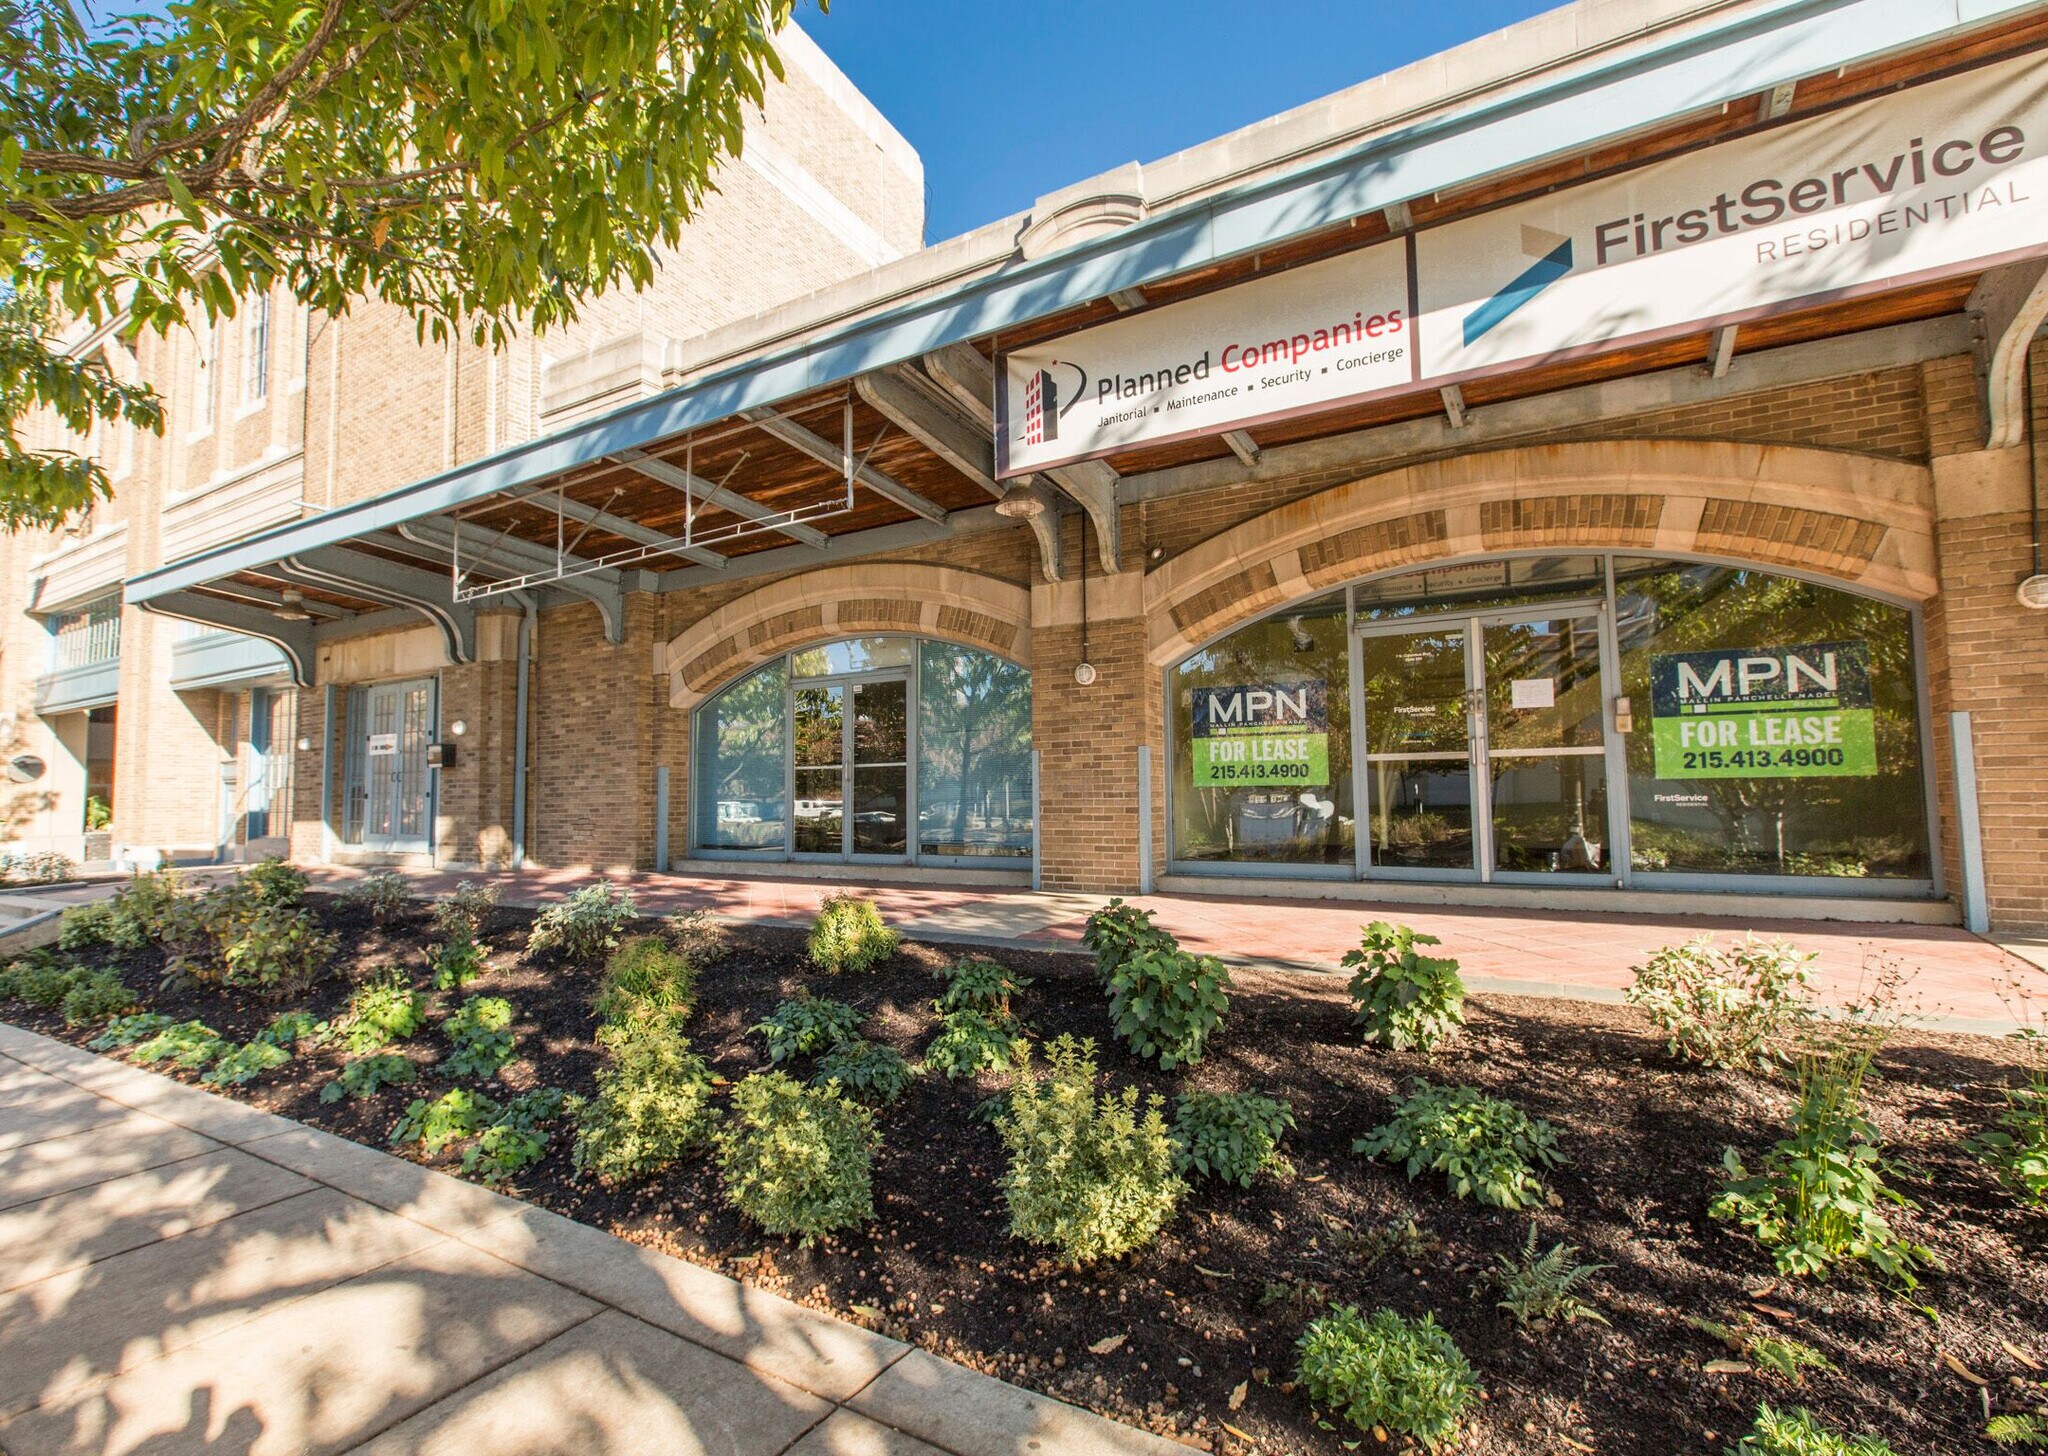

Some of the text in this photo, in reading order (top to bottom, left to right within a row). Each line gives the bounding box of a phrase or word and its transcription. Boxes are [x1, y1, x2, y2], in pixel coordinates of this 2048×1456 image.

[1595, 125, 2024, 266] FirstService
[1757, 180, 2030, 264] RESIDENTIAL
[1097, 309, 1403, 405] Planned Companies
[1097, 346, 1404, 428] Janitorial Maintenance Security Concierge
[1677, 652, 1838, 698] MPN
[1209, 688, 1307, 723] MPN
[1798, 691, 1838, 699] NADEL
[1680, 715, 1843, 748] FOR LEASE
[1210, 738, 1309, 762] FOR LEASE
[1683, 748, 1843, 769] 215.413.4900
[1210, 763, 1309, 779] 215.413.4900
[1654, 793, 1709, 802] FirstService
